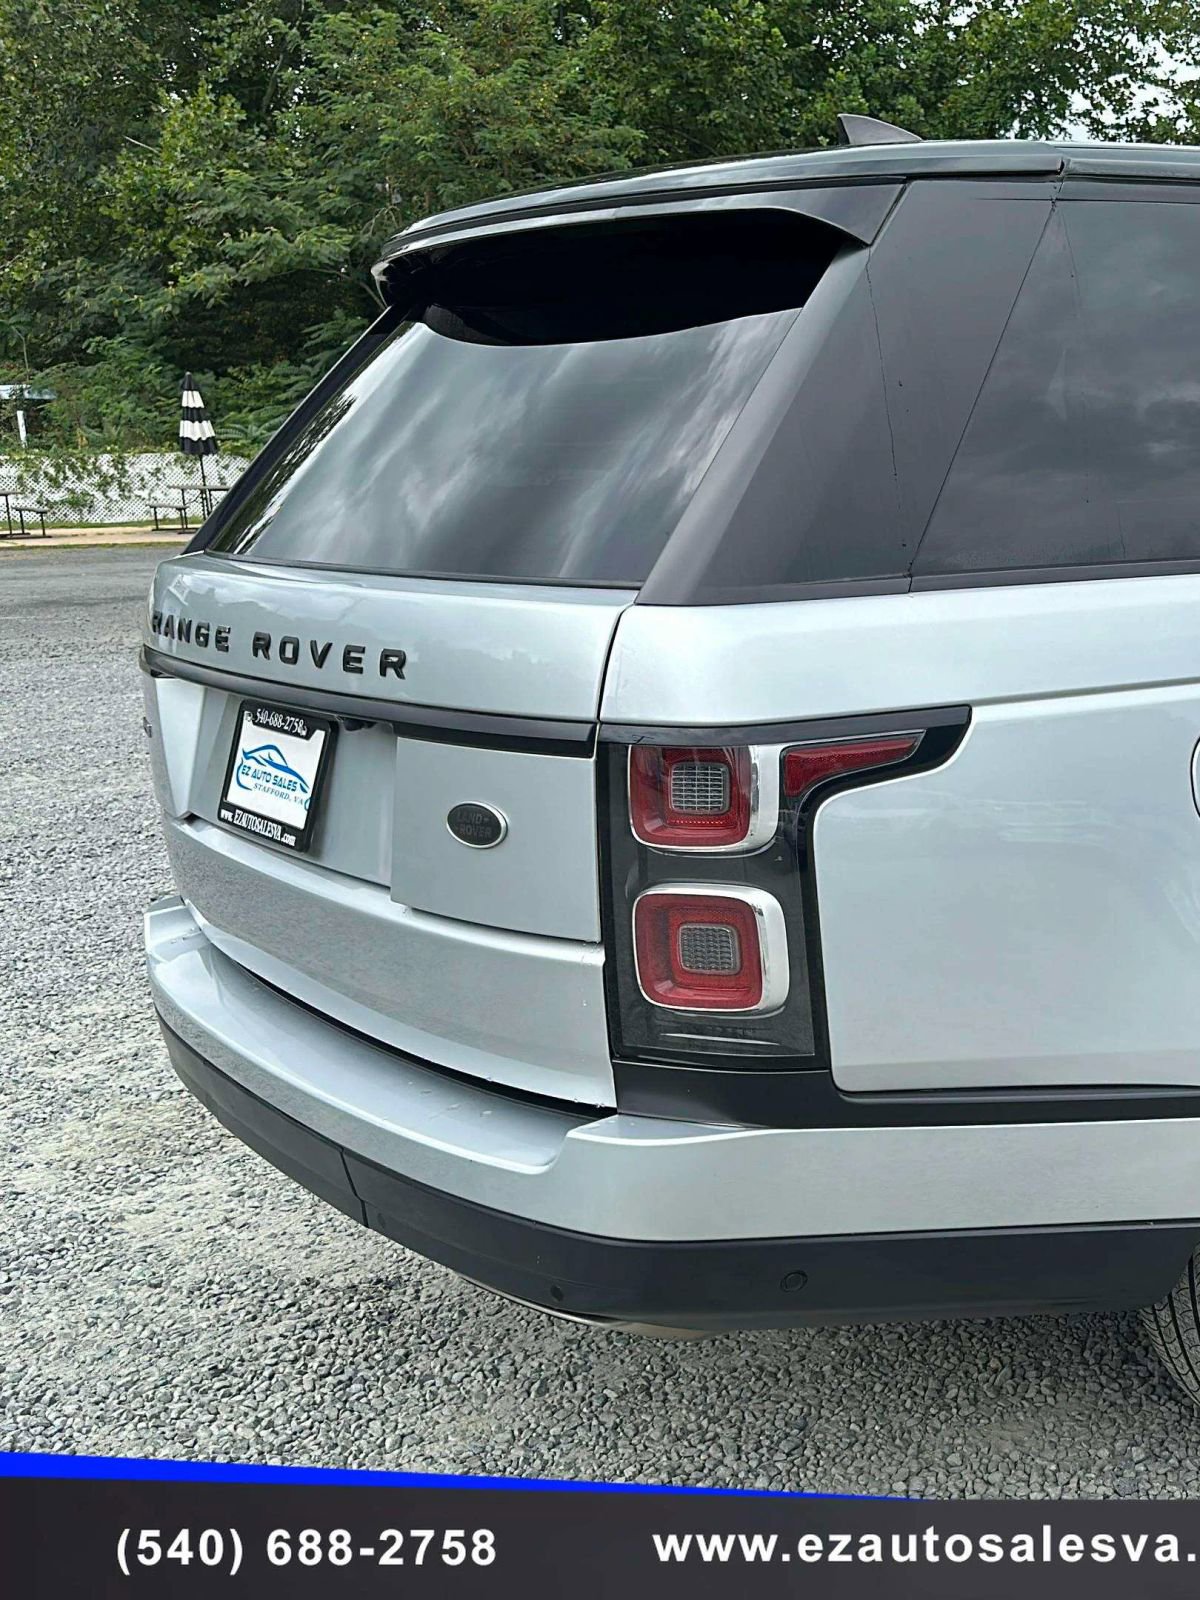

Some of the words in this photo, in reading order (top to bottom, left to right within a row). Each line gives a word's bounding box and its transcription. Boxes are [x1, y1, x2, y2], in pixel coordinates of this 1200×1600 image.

[151, 610, 232, 653] RANGE
[252, 630, 408, 680] ROVER
[254, 708, 304, 736] 540-688-2758
[241, 764, 252, 777] EZ
[252, 768, 272, 784] AUTO
[273, 775, 299, 792] SALES
